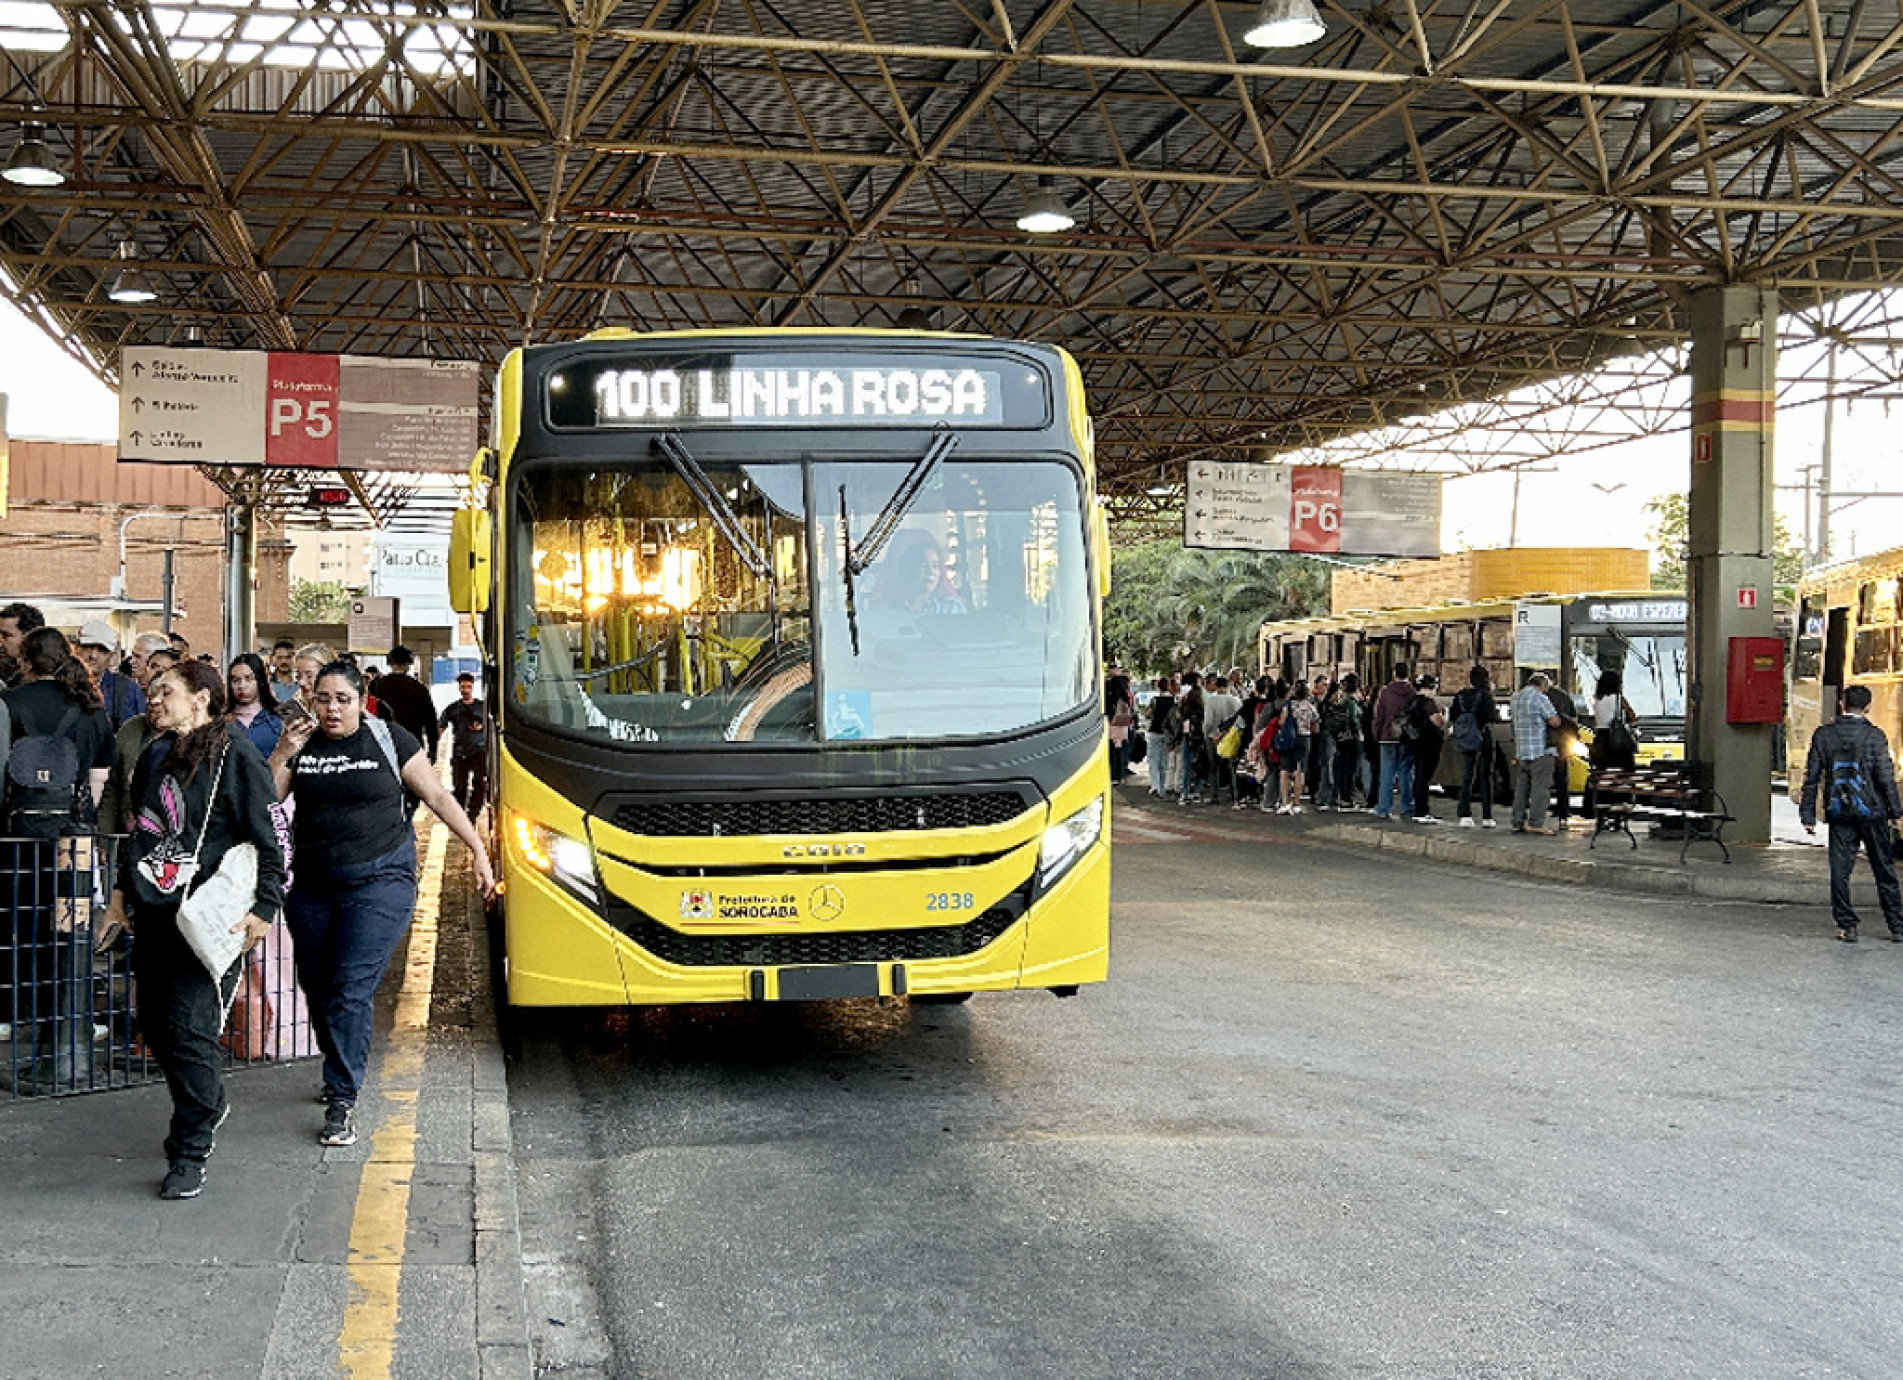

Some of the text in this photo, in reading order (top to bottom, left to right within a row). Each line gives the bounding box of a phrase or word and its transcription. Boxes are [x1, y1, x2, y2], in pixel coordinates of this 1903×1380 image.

[596, 369, 986, 417] 100 LINHA ROSA
[271, 398, 332, 439] P5
[1294, 501, 1338, 531] P6
[1517, 610, 1530, 625] R
[781, 894, 796, 904] de
[926, 893, 975, 911] 2838
[718, 905, 799, 919] SOROCABA
